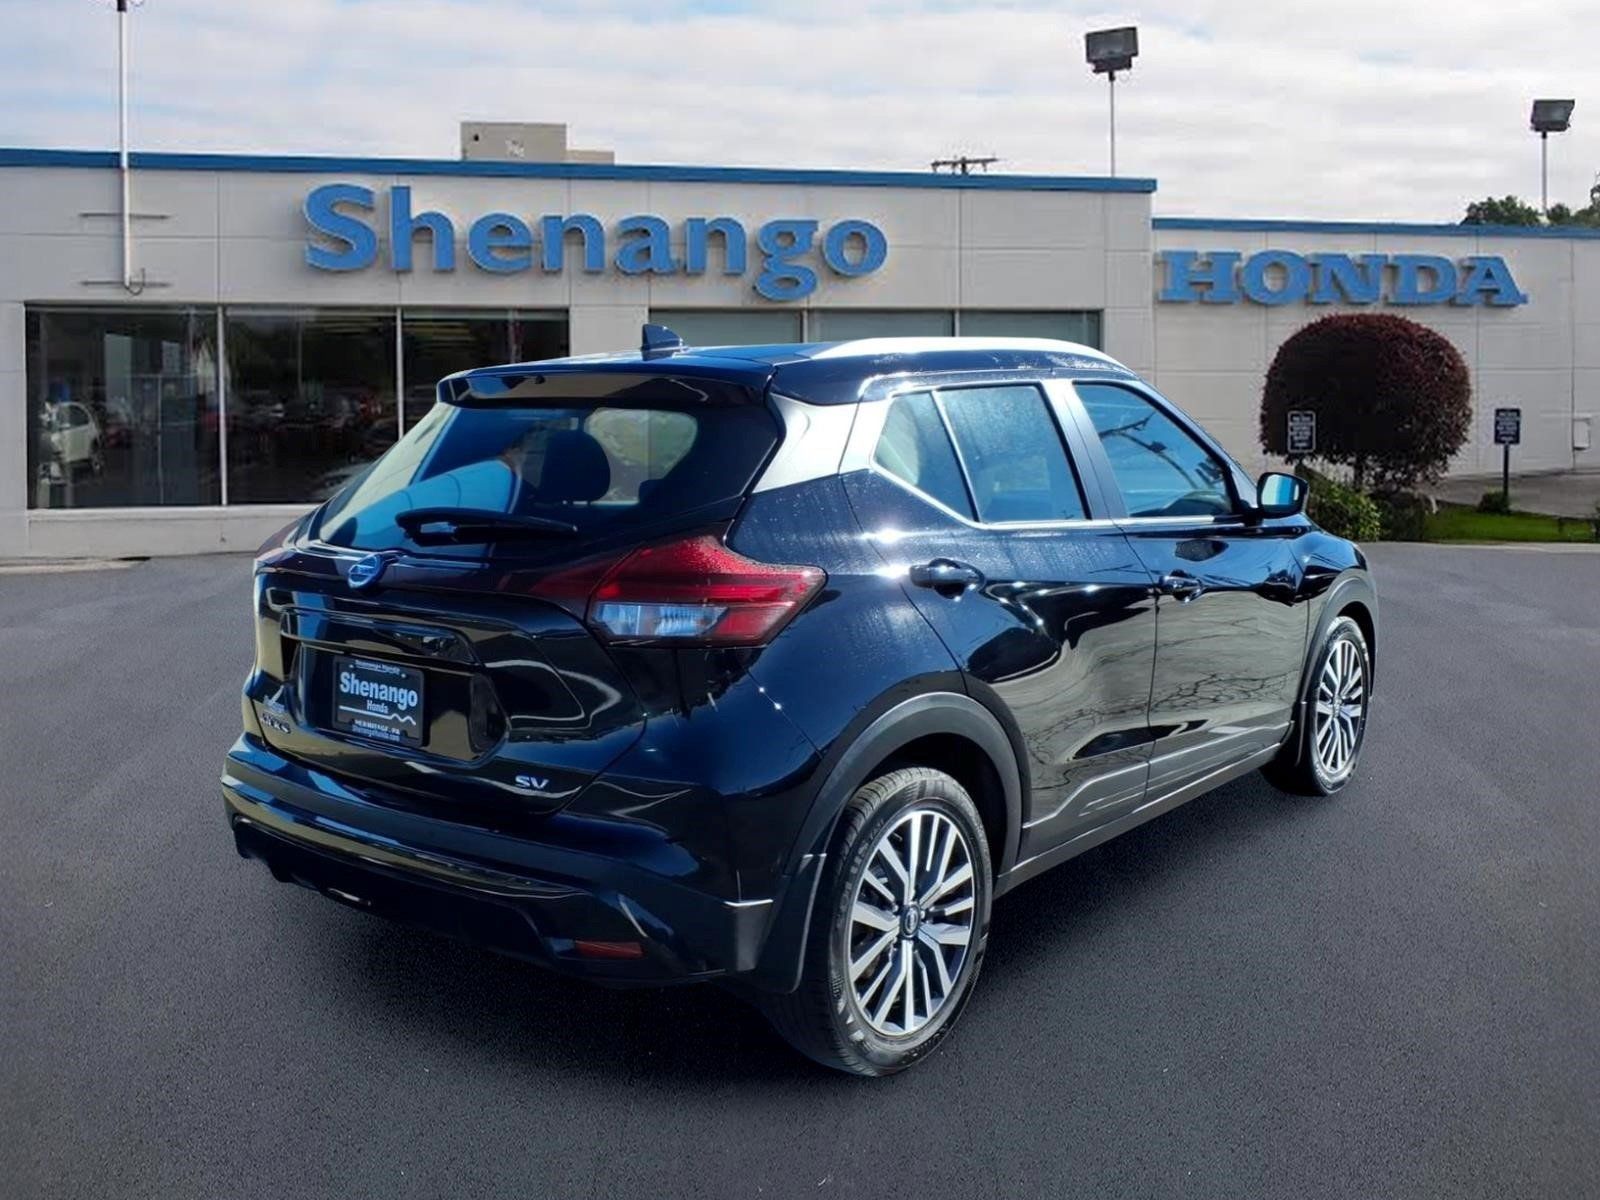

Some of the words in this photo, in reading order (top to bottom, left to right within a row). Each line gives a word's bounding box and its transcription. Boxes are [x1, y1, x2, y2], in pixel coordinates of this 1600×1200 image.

[303, 183, 888, 301] Shenango
[1157, 249, 1528, 306] HONDA
[340, 671, 418, 710] Shenango
[366, 700, 389, 714] Honda
[515, 775, 549, 789] SV
